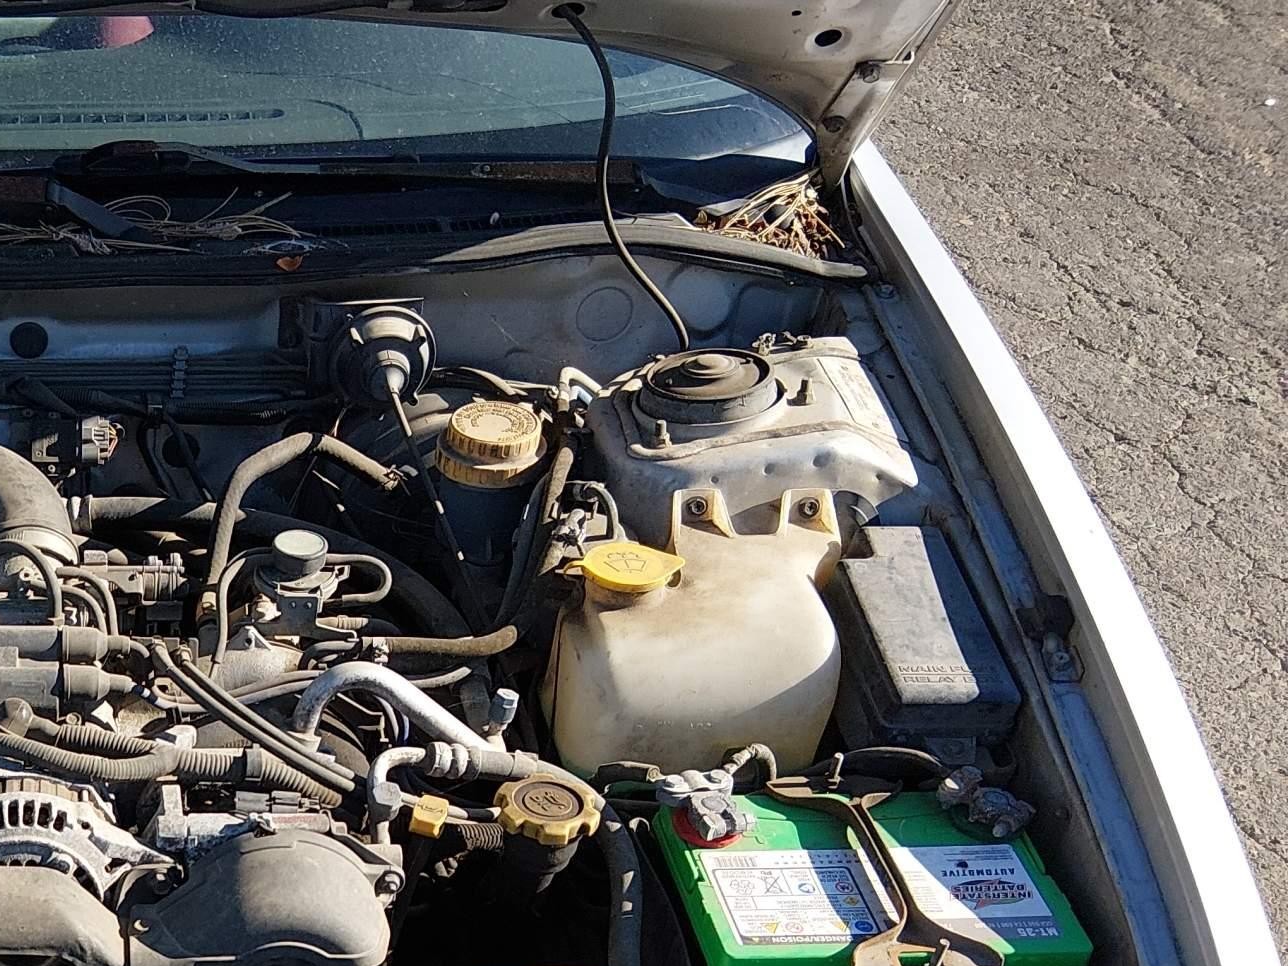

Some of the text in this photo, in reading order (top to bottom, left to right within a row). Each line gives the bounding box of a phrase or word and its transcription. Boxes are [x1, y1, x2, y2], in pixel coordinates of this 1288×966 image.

[898, 665, 948, 673] MAIN
[941, 868, 1015, 877] AUTOMOTIVE
[952, 883, 1026, 892] BATTERIES
[951, 890, 1032, 900] INTERSTATE
